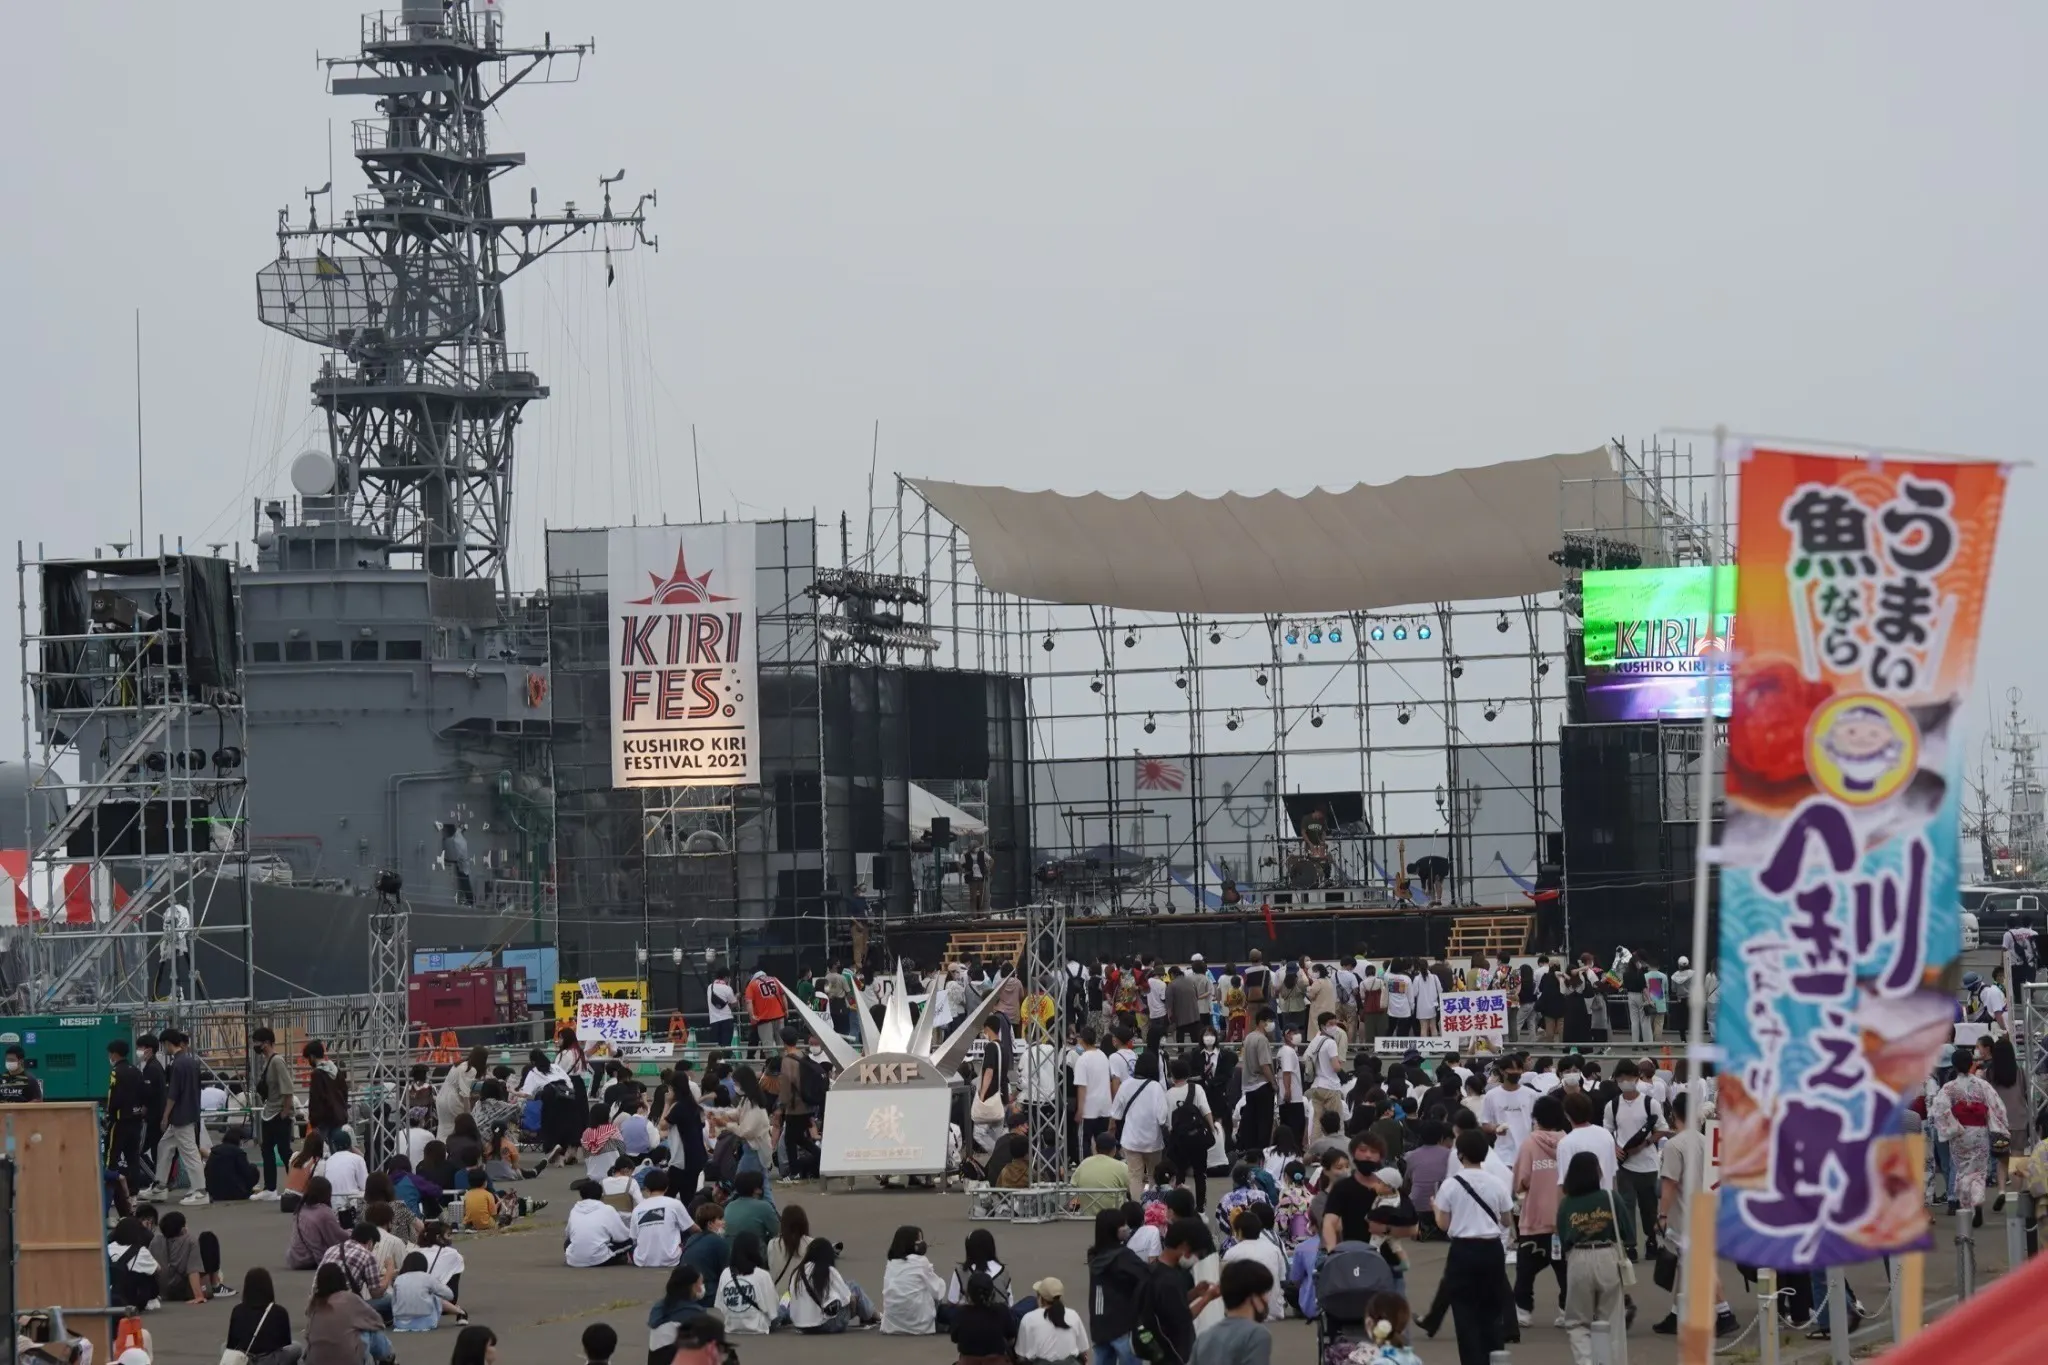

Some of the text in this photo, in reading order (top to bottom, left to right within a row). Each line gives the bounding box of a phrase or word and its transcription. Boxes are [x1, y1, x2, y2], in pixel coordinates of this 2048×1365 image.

[1873, 480, 1954, 689] うまい
[621, 612, 742, 666] KIRI
[1615, 617, 1698, 660] KIRI
[1615, 661, 1674, 674] KUSHIRO
[1679, 660, 1706, 673] KIRI
[623, 736, 746, 754] KUSHIRO KIRI
[624, 753, 747, 770] FESTIVAL 2021
[580, 1002, 637, 1019] 感染対策に
[581, 1018, 619, 1029] ご協力
[1443, 1013, 1504, 1033] 撮影禁止
[600, 1028, 638, 1040] ください
[860, 1063, 918, 1084] KKF
